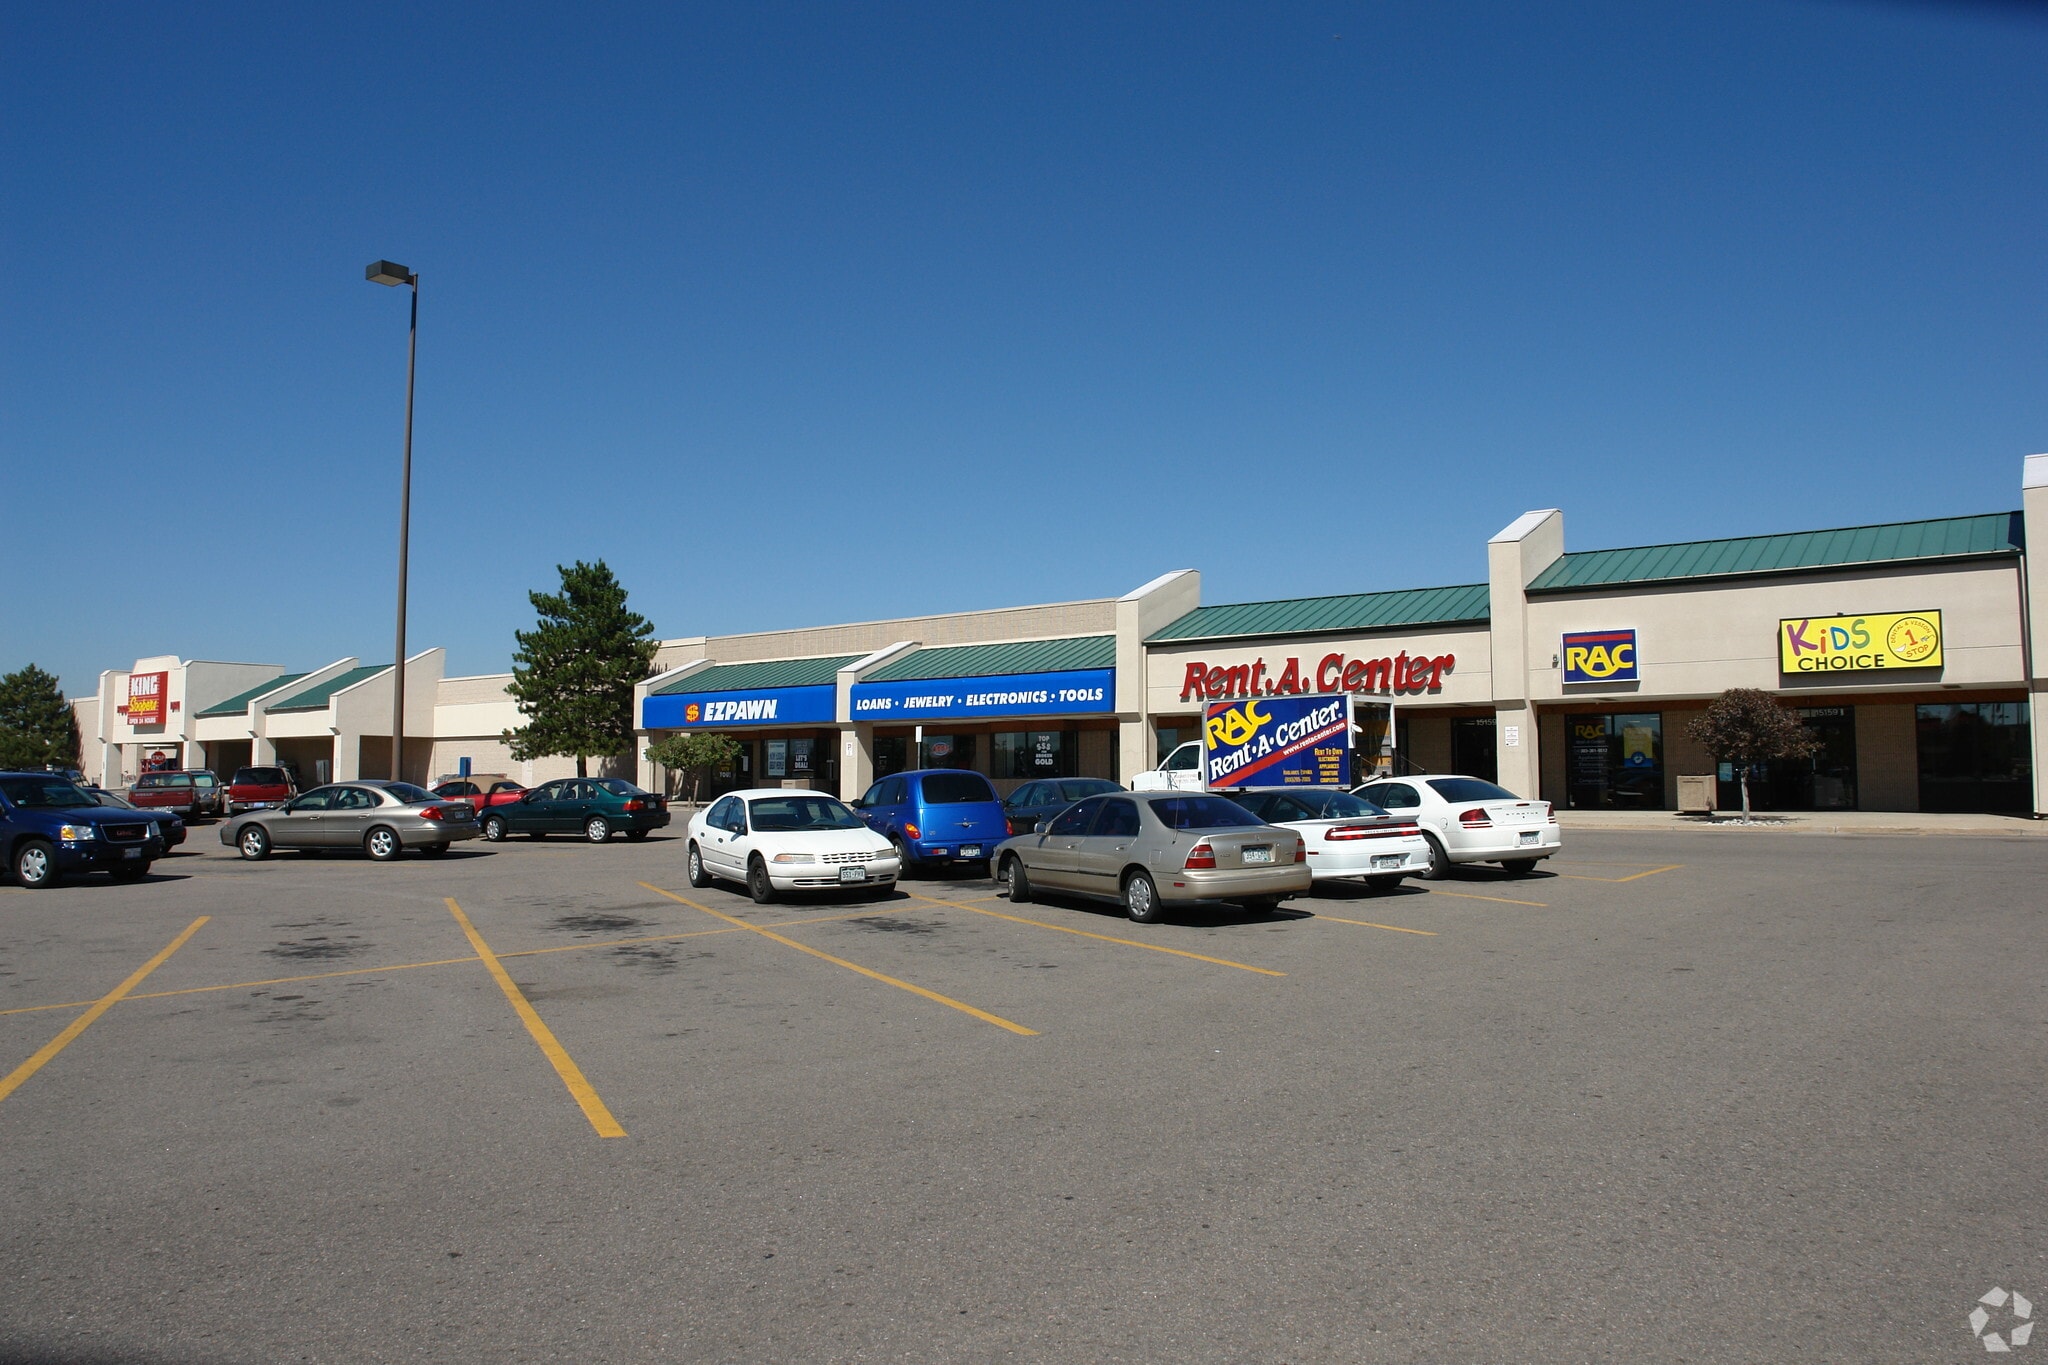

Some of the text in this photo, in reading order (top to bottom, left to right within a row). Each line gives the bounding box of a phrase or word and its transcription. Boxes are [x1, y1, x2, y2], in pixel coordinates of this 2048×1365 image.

[1890, 624, 1904, 644] DENTAL
[1910, 620, 1931, 634] VISION
[1904, 629, 1919, 646] 1
[1566, 643, 1634, 678] RAC
[1906, 644, 1929, 658] STOP
[1797, 653, 1885, 671] CHOICE
[131, 675, 159, 695] KING
[856, 687, 1103, 711] LOANS JEWELRY ELECTRONICS TOOLS
[703, 699, 777, 722] EZPAWN
[1206, 700, 1273, 751] RAC
[1575, 724, 1605, 739] RAC
[1282, 722, 1346, 756] www.rentacenter.com
[151, 753, 165, 762] STOP
[1035, 758, 1054, 766] GOLD
